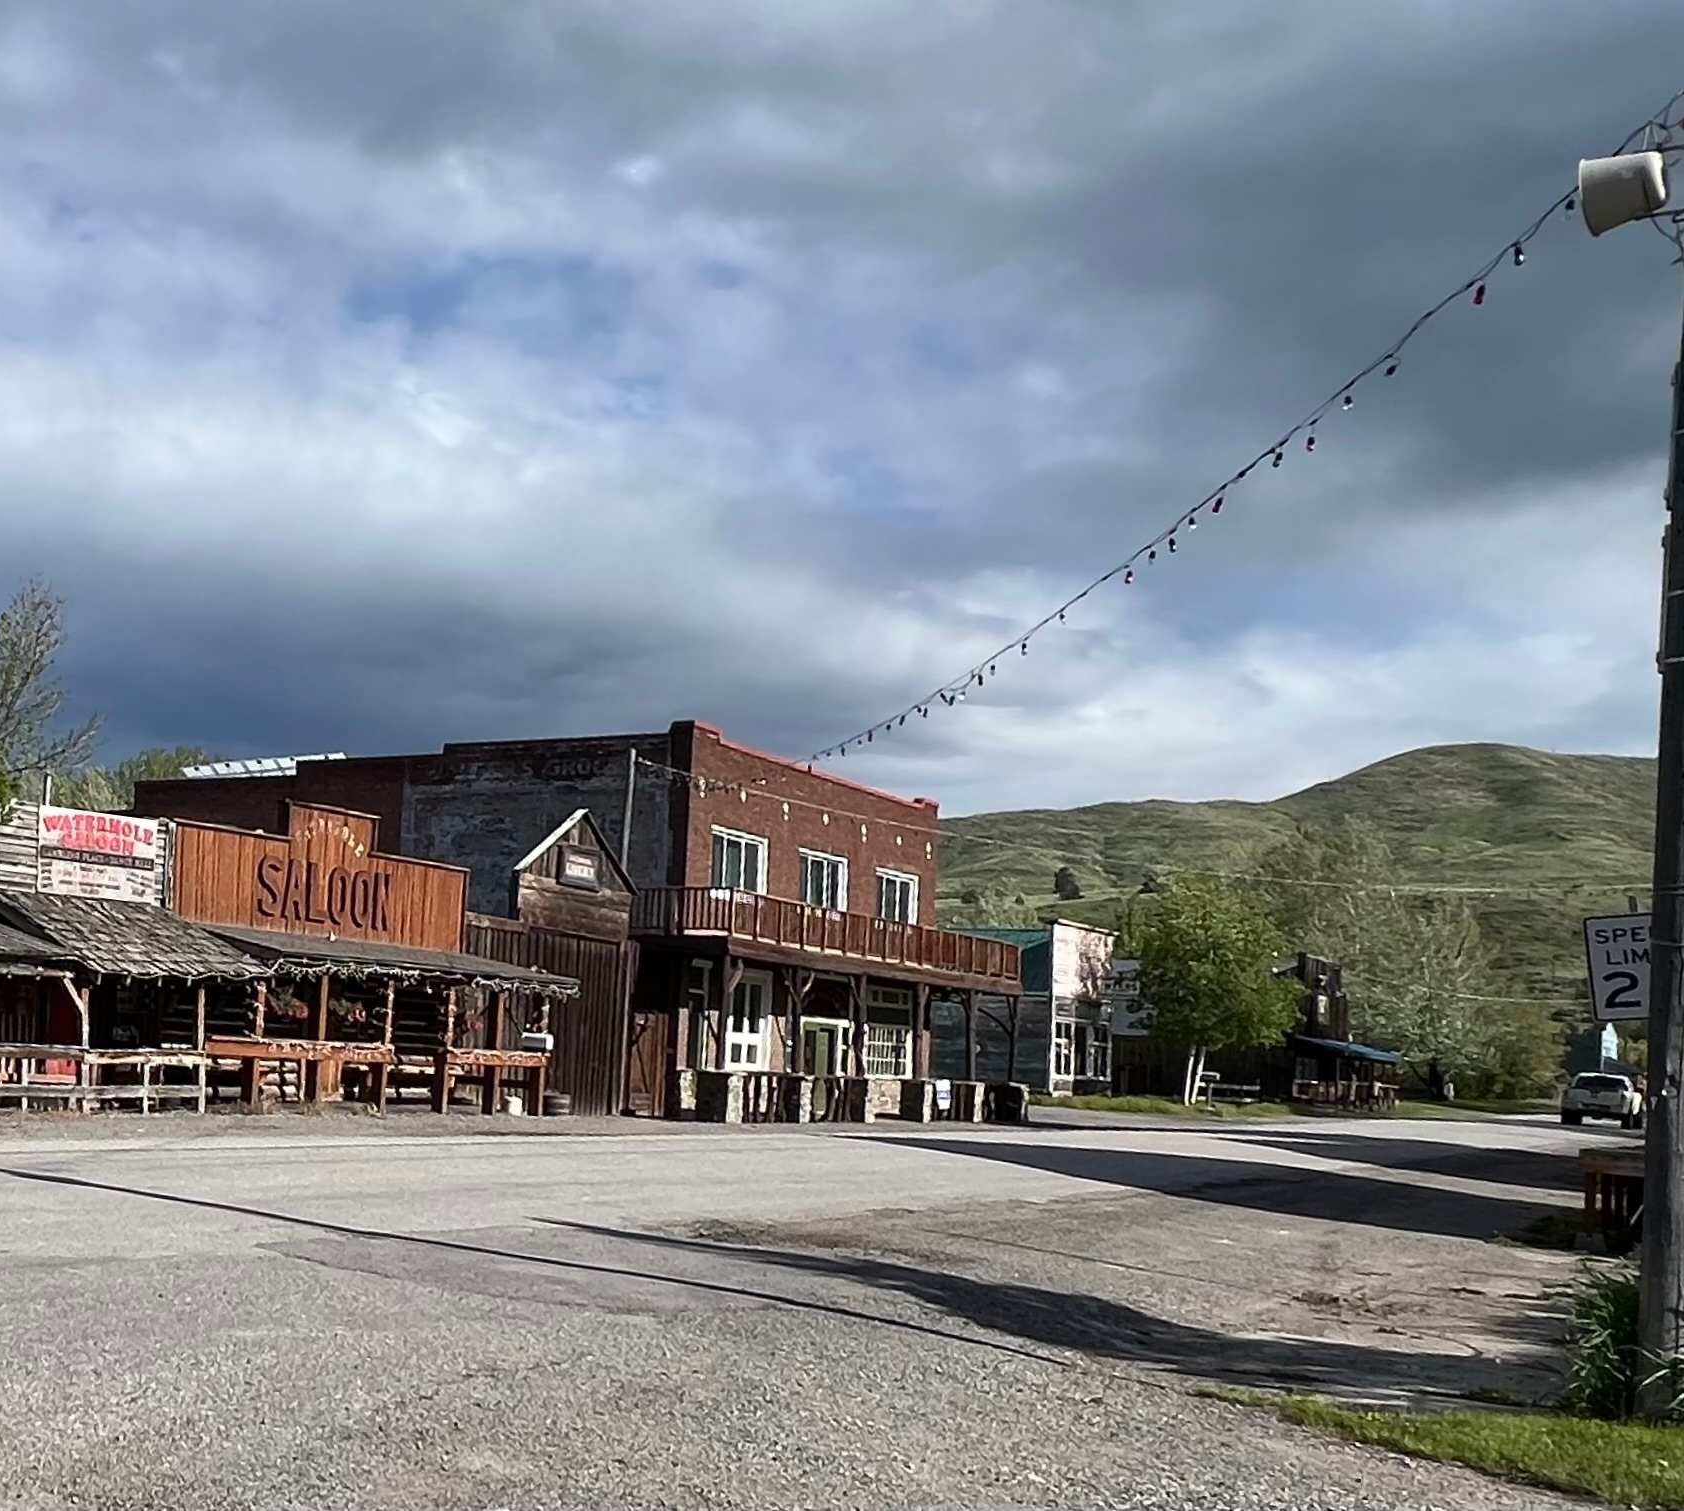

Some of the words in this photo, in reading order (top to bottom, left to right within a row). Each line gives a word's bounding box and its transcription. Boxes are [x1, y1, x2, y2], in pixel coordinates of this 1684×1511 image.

[256, 855, 392, 932] SALOON
[1595, 926, 1651, 945] SPE
[1606, 948, 1651, 965] LIM
[1602, 971, 1643, 1009] 2
